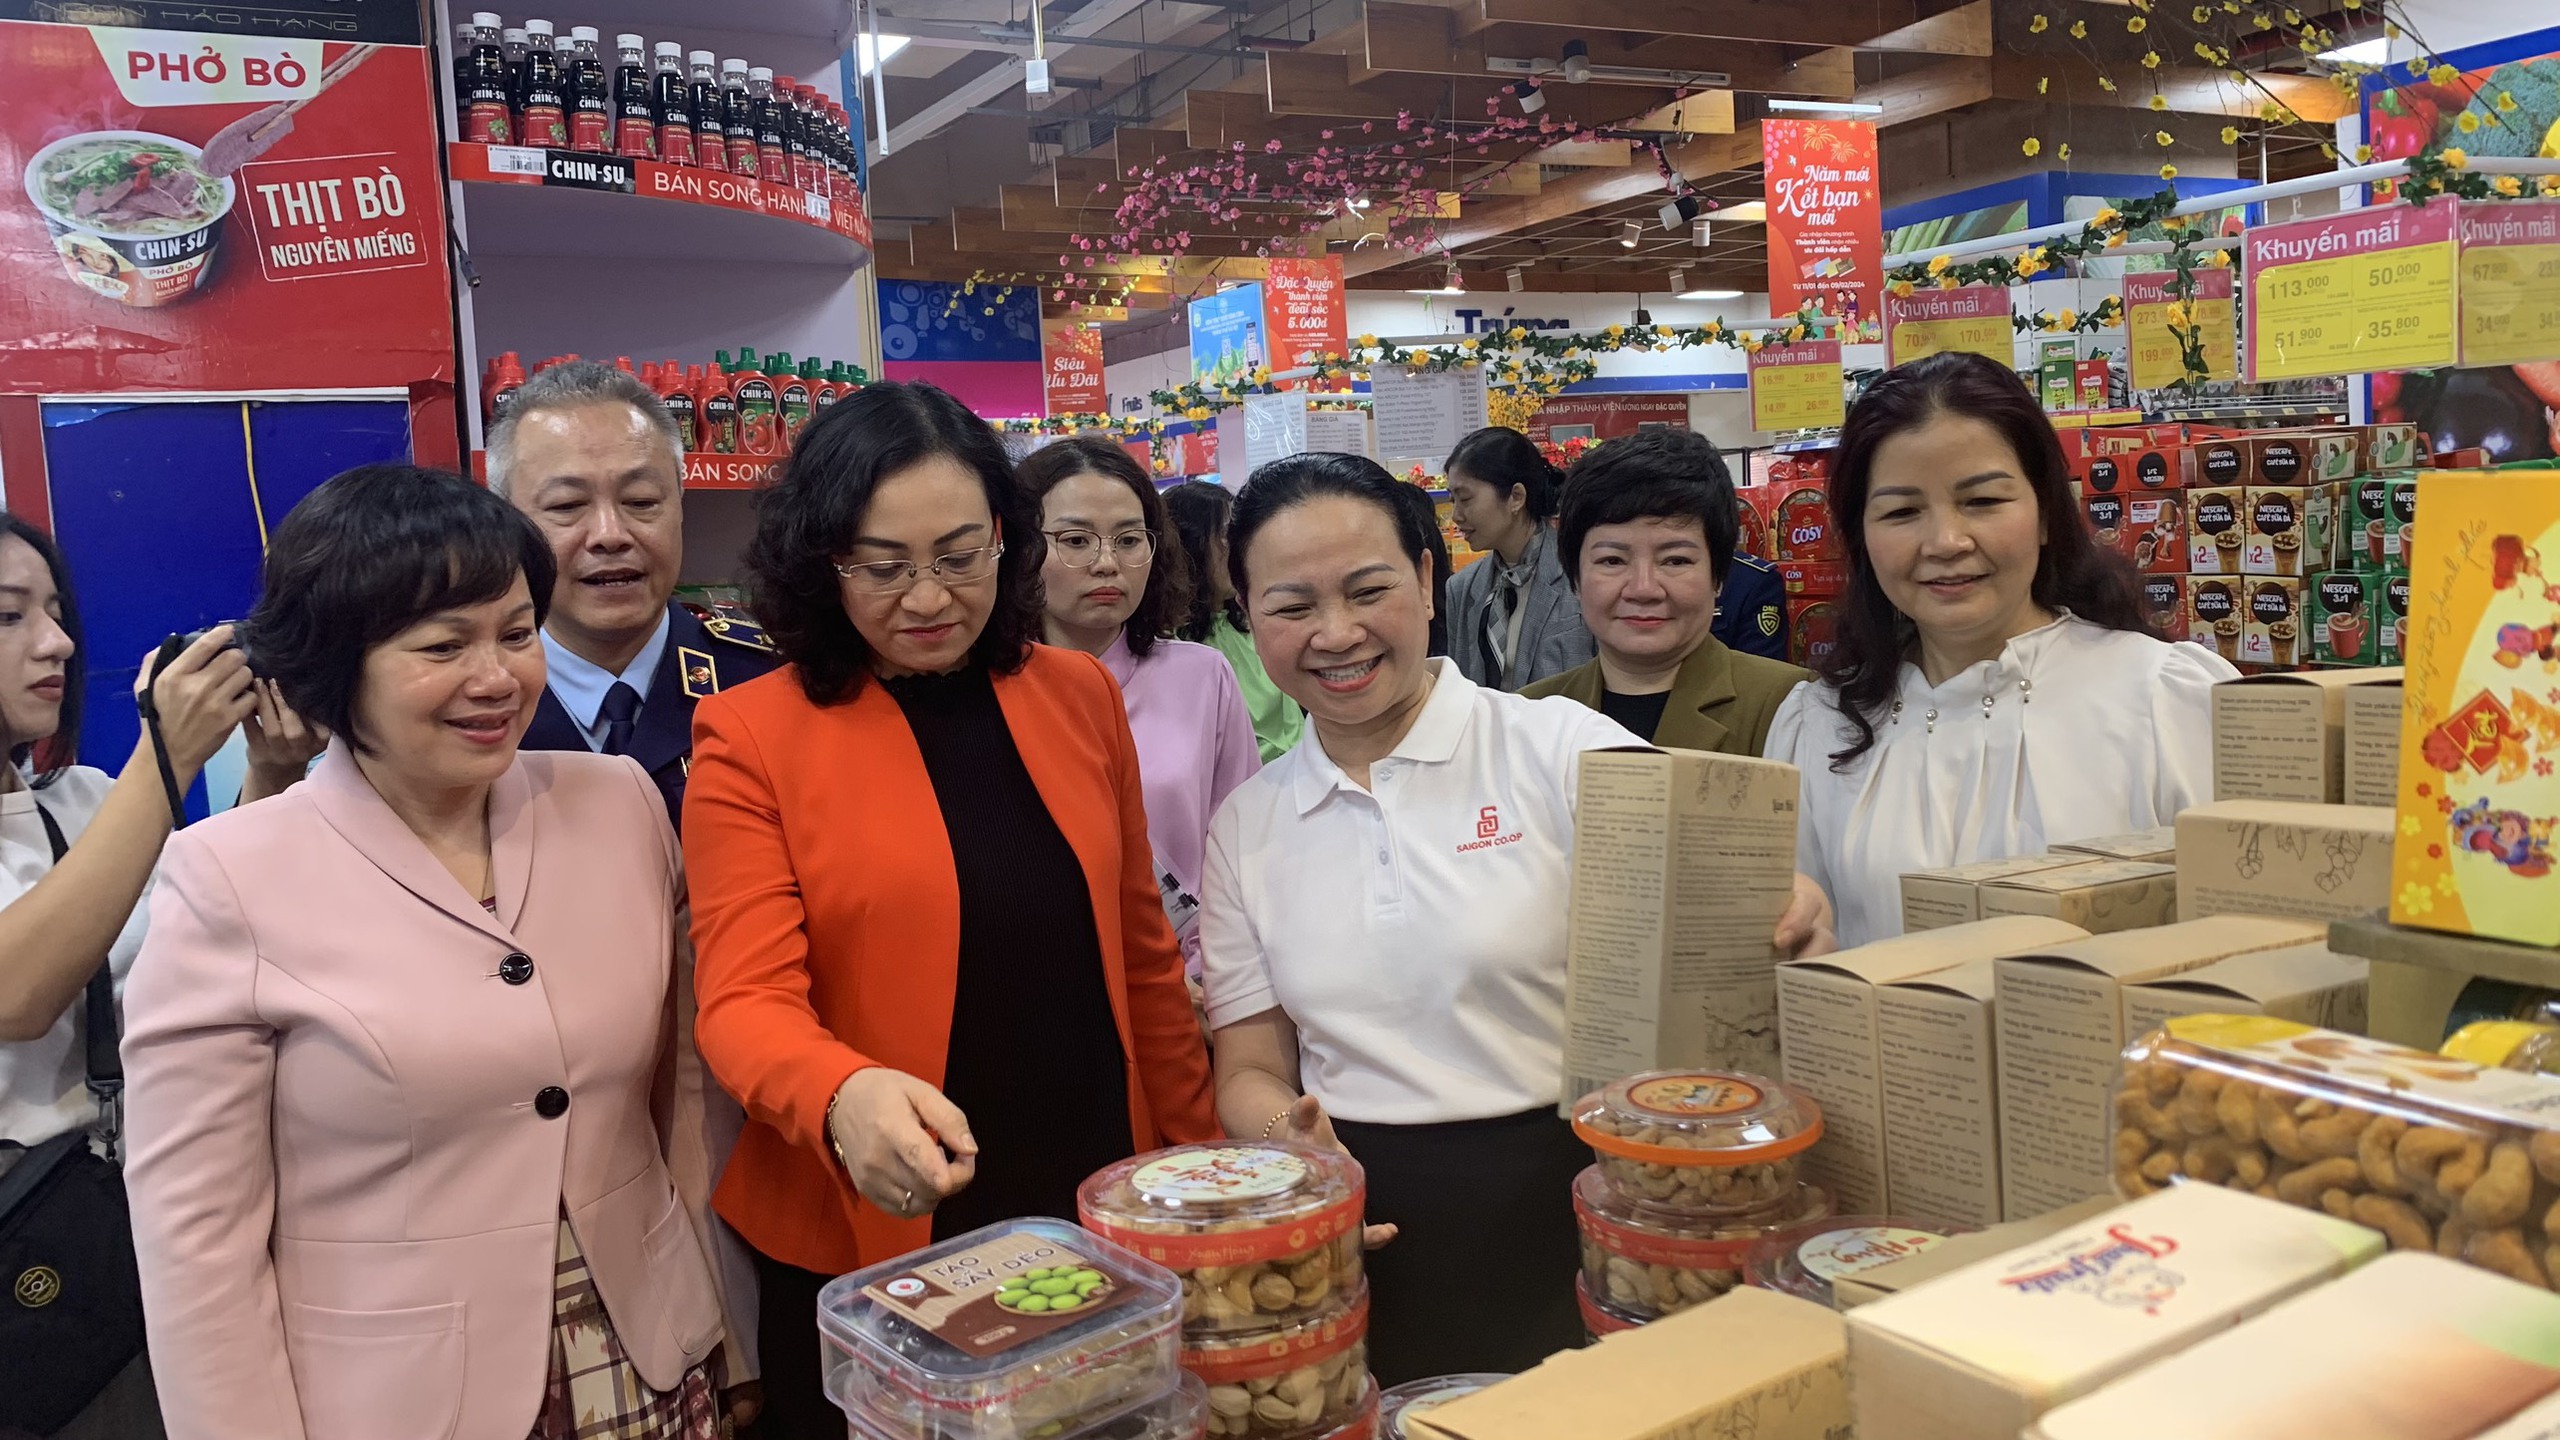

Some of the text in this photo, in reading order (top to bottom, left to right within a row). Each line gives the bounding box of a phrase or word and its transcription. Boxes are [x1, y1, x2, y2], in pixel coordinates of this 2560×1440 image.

[127, 46, 307, 88] PHỞ BÒ
[472, 90, 506, 101] CHIN-SU
[529, 93, 562, 105] CHIN-SU
[579, 98, 607, 110] CHIN-S
[625, 105, 651, 117] CHIN-
[551, 160, 625, 185] CHIN-SU
[1804, 164, 1871, 183] Năm mới
[256, 166, 406, 237] THỊT BÒ
[654, 170, 702, 196] BÁN
[708, 180, 762, 206] SONG
[834, 208, 853, 235] VIỆT
[1775, 178, 1861, 218] Kết bạn
[1807, 208, 1837, 225] mới
[2460, 213, 2557, 244] Khuyến mãi
[135, 227, 209, 260] CHIN-SU
[270, 226, 416, 268] NGUYÊN MIẾNG
[2256, 226, 2348, 261] Khuyến
[2355, 218, 2400, 247] mãi
[2128, 279, 2177, 302] Khuy
[2268, 262, 2421, 300] 113.000 50.000
[1890, 294, 1979, 320] Khuyến mãi
[2274, 315, 2420, 350] 51.900 35.800
[1053, 355, 1087, 371] Siêu
[1752, 347, 1817, 365] Khuyến mãi
[1069, 372, 1100, 388] Đãi
[741, 388, 772, 400] CHIN-SU
[783, 393, 809, 403] CHIN-SU
[664, 400, 693, 410] CHIN-SU
[708, 401, 735, 411] CHIN-SU
[1572, 400, 1601, 413] THÀNH
[1602, 400, 1621, 412] VIÊN
[1791, 525, 1824, 545] COSY
[1786, 570, 1803, 579] COSY
[1456, 839, 1493, 853] SAIGON
[929, 1256, 980, 1279] TÁO
[952, 1246, 1055, 1290] SẤY DẺO
